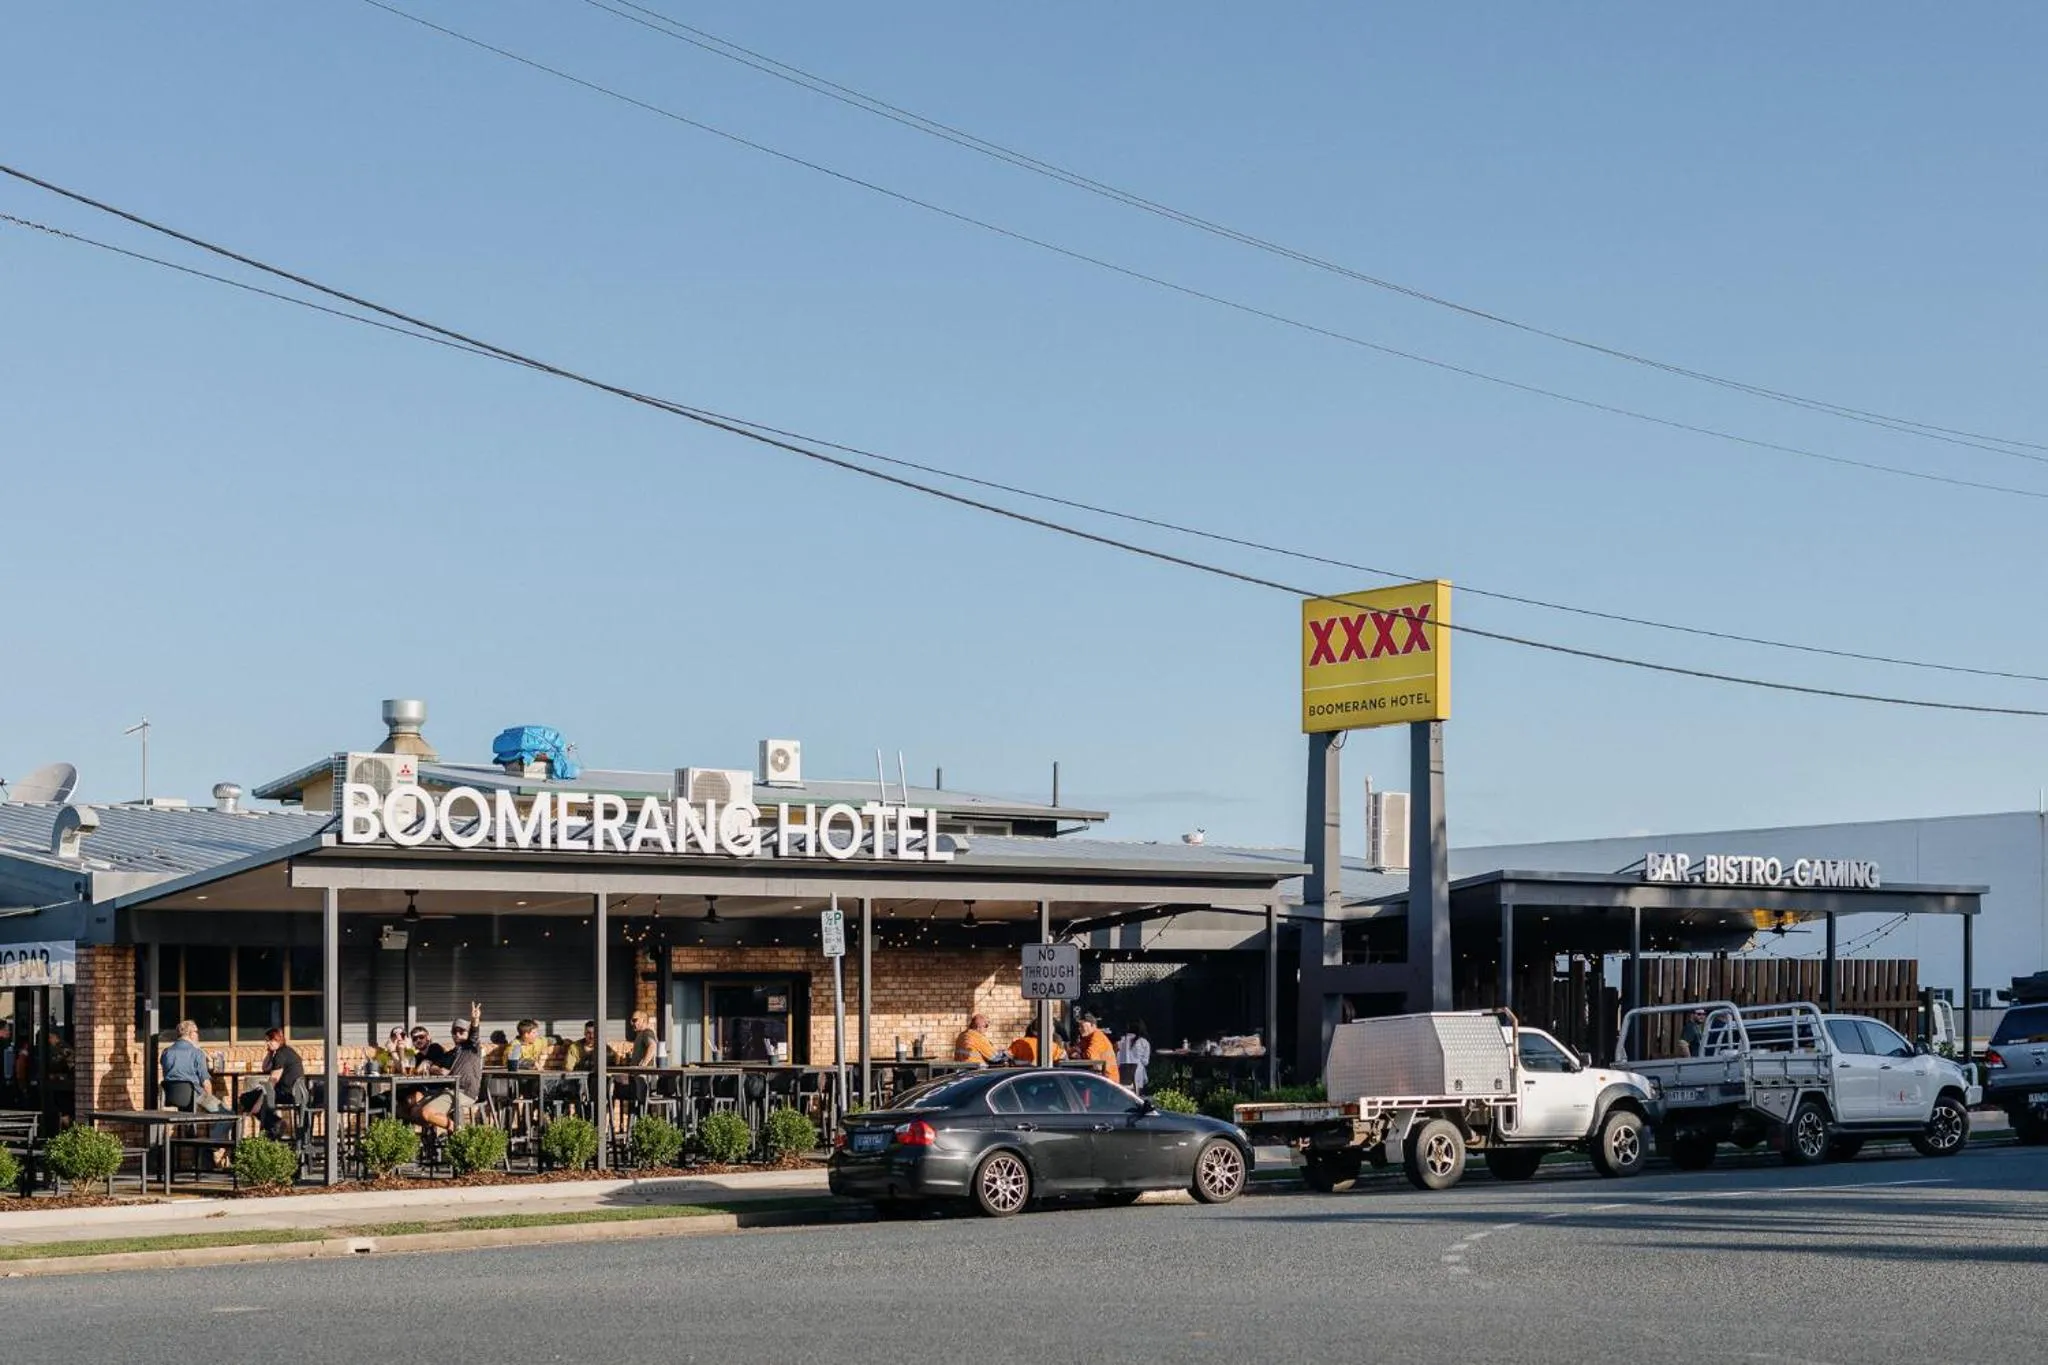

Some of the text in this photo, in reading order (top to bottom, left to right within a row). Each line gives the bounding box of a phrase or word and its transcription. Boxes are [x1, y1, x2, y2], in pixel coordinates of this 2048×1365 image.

[1309, 604, 1432, 666] XXXX
[1309, 693, 1432, 716] BOOMERANG HOTEL
[342, 783, 955, 861] BOOMERANG HOTEL
[1794, 858, 1881, 888] GAMING
[1038, 949, 1055, 961] NO
[1024, 965, 1074, 978] THROUGH
[1031, 982, 1066, 995] ROAD
